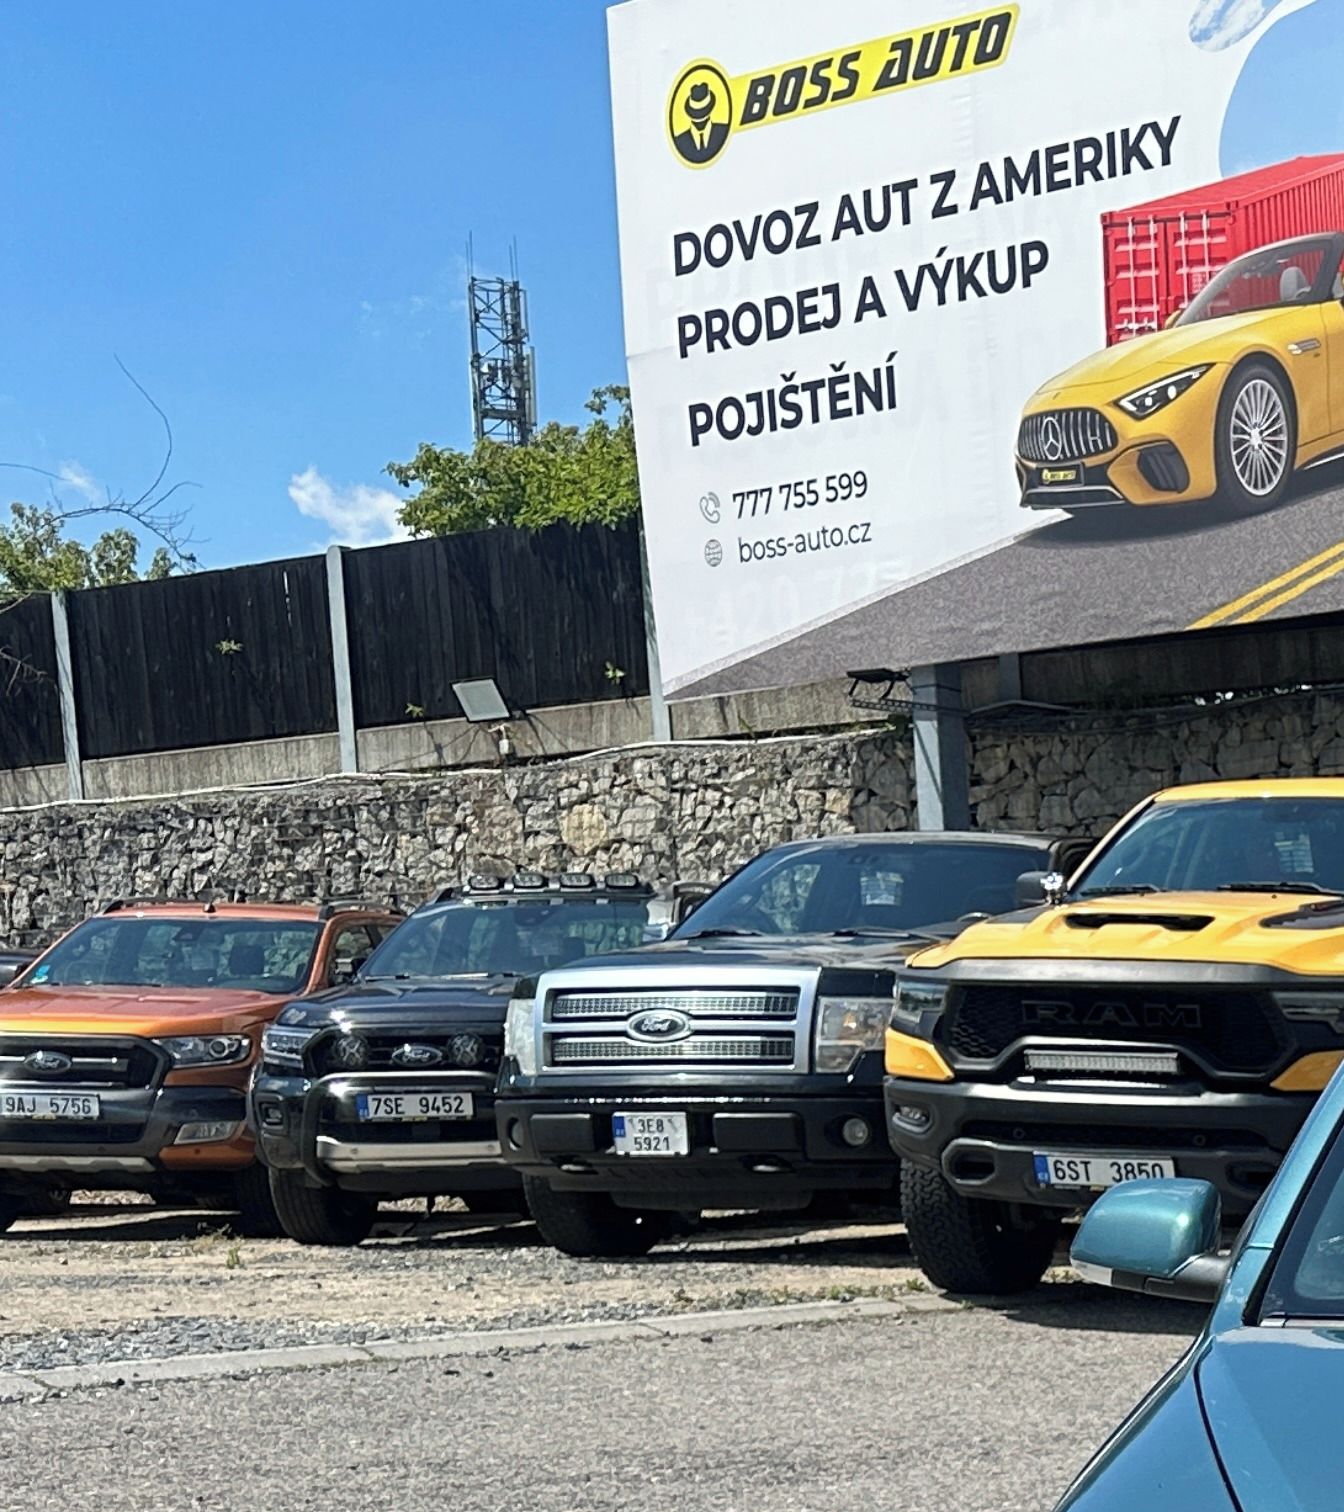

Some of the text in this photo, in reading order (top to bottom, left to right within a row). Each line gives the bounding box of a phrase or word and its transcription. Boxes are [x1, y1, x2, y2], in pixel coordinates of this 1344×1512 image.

[739, 11, 1012, 126] BOSS AUTO
[673, 115, 1182, 276] DOVOZ AUT Z AMERIKY
[677, 240, 1049, 359] PRODEJ A VÝKUP
[688, 351, 899, 447] POJIŠTĚNÍ
[732, 470, 868, 519] 777 755 599
[738, 522, 872, 563] boss-auto.cz
[1021, 1000, 1202, 1028] RAM
[5, 1097, 91, 1114] 9AJ 5756
[372, 1097, 405, 1115] 7SE
[420, 1096, 464, 1114] 9452
[634, 1136, 670, 1151] 5921
[1053, 1160, 1091, 1181] 6ST
[1110, 1162, 1164, 1182] 3850
